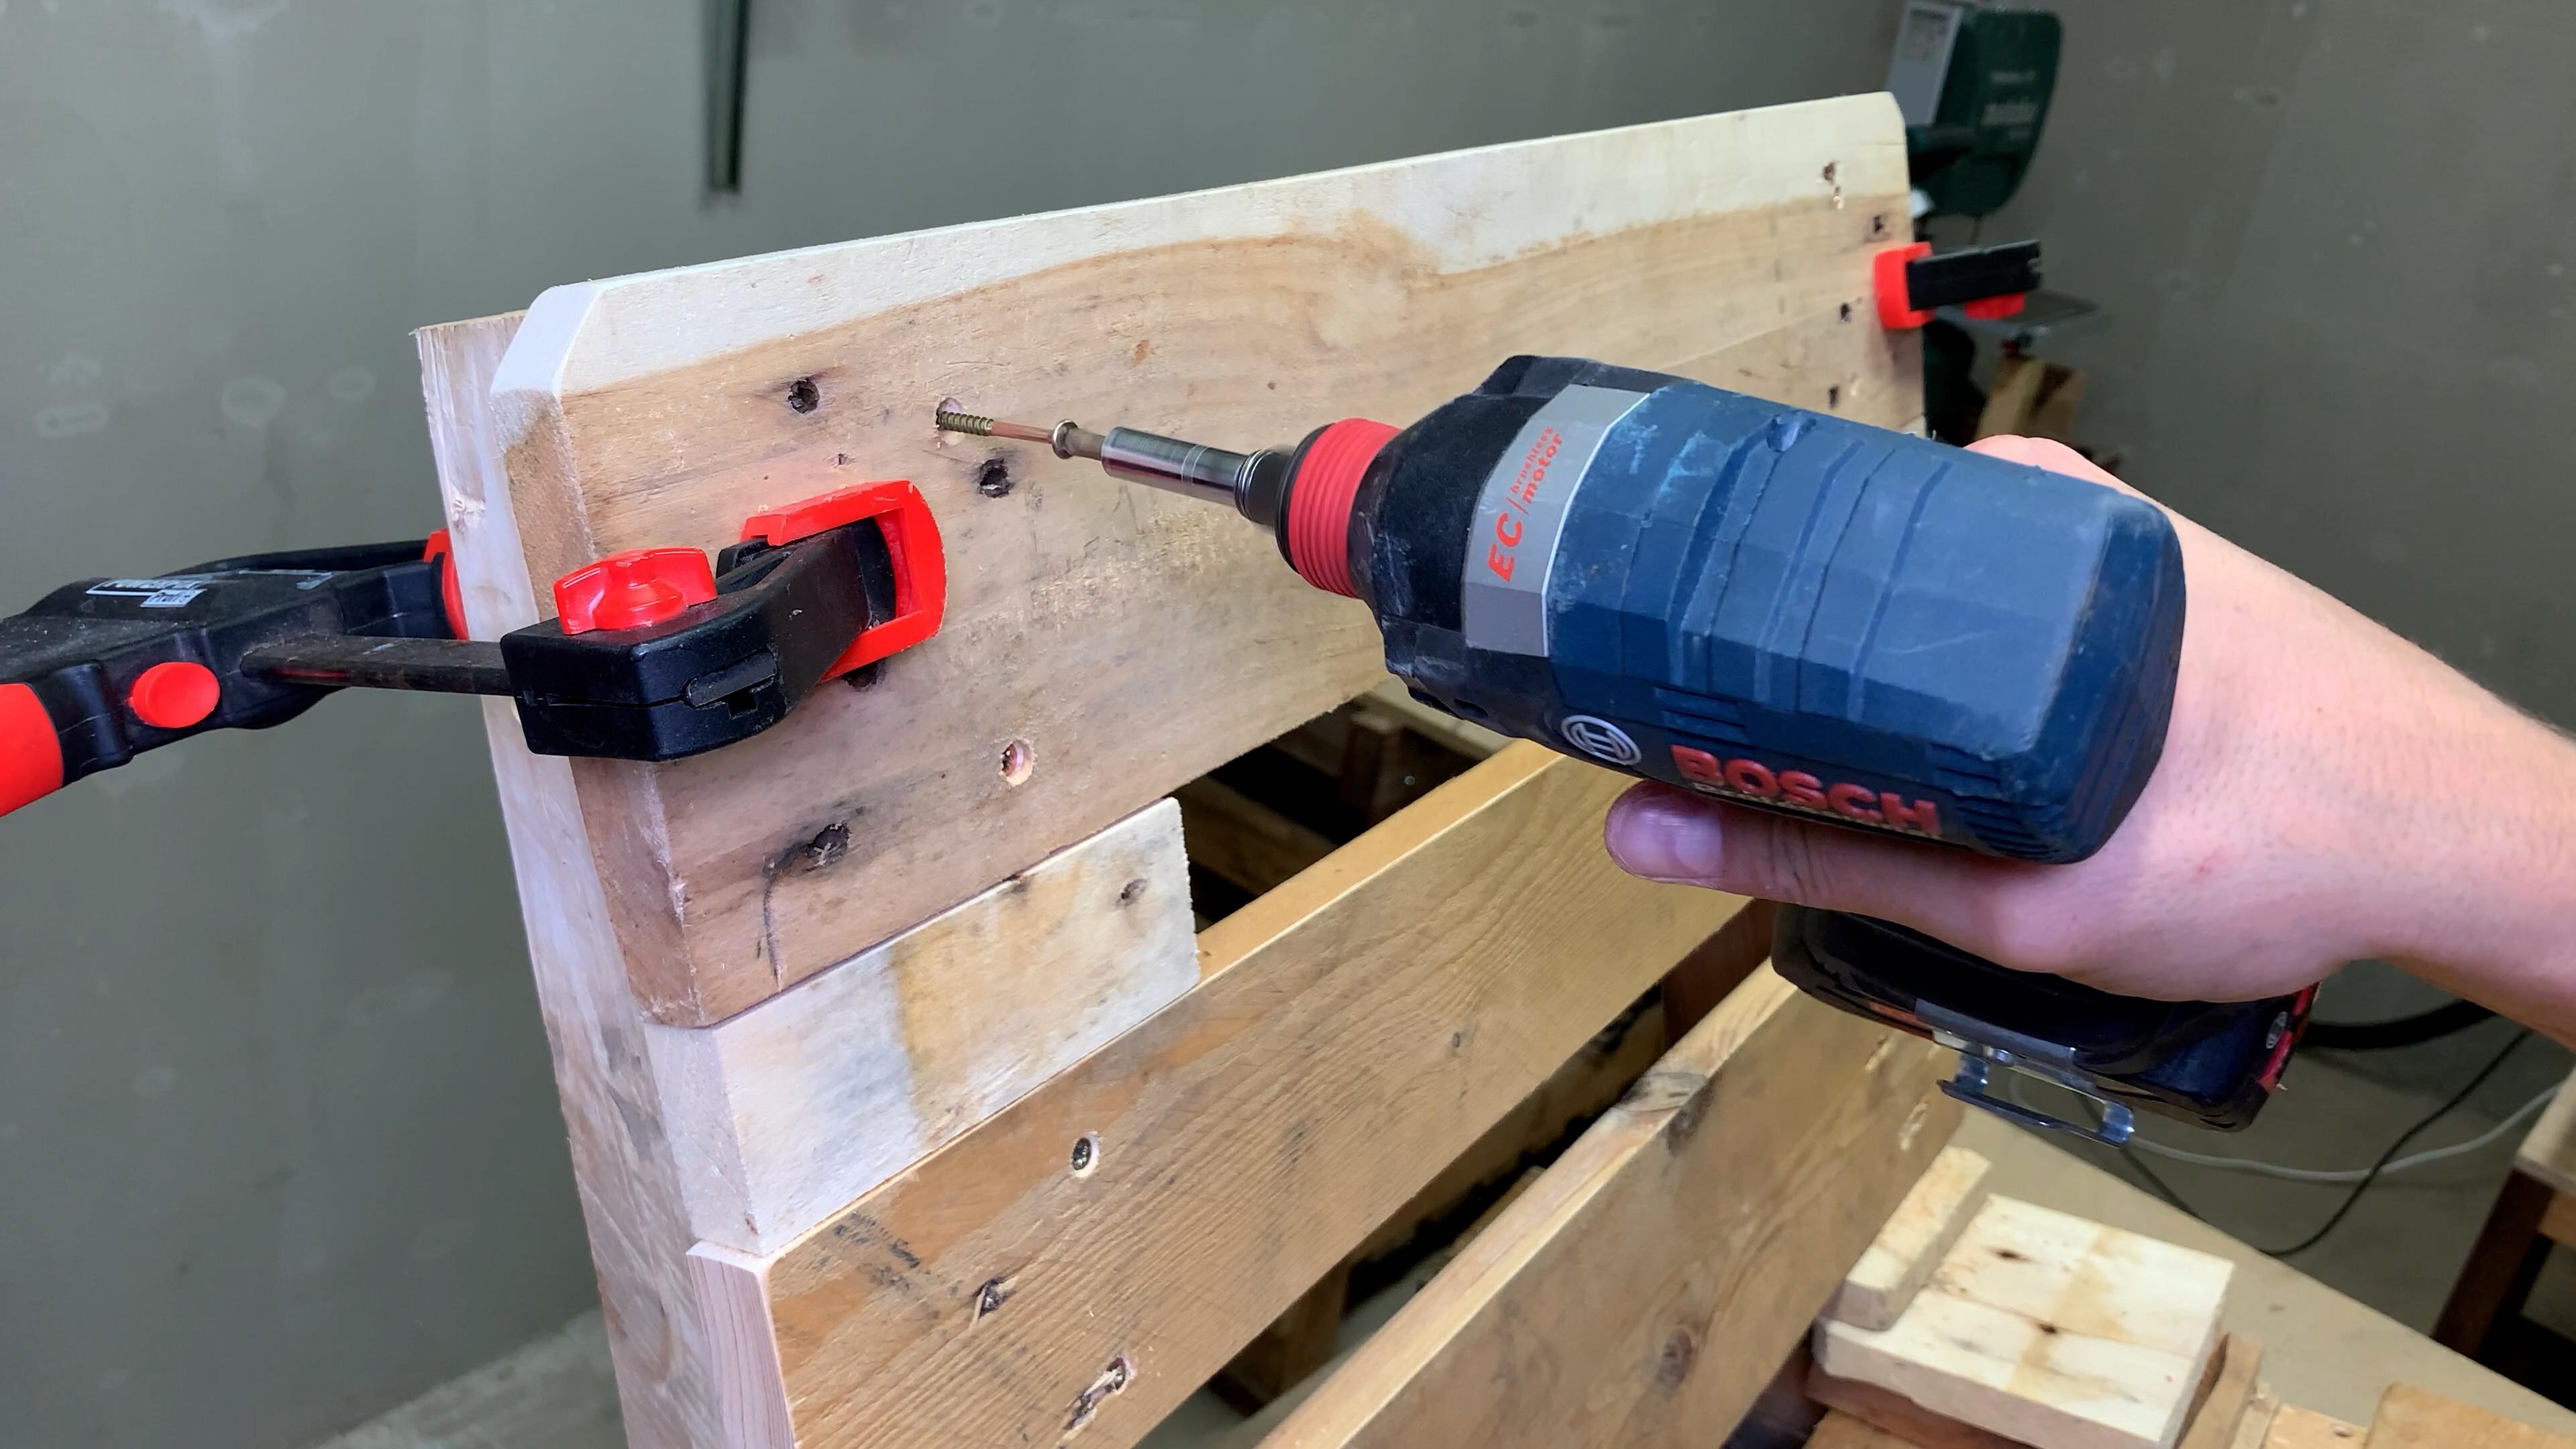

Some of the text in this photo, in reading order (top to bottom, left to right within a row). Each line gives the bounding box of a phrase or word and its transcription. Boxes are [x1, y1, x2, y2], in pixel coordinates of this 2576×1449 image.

[1511, 425, 1553, 494] brushless
[1521, 433, 1562, 504] motor
[1487, 512, 1523, 582] EC
[1671, 745, 1942, 837] BOSCH
